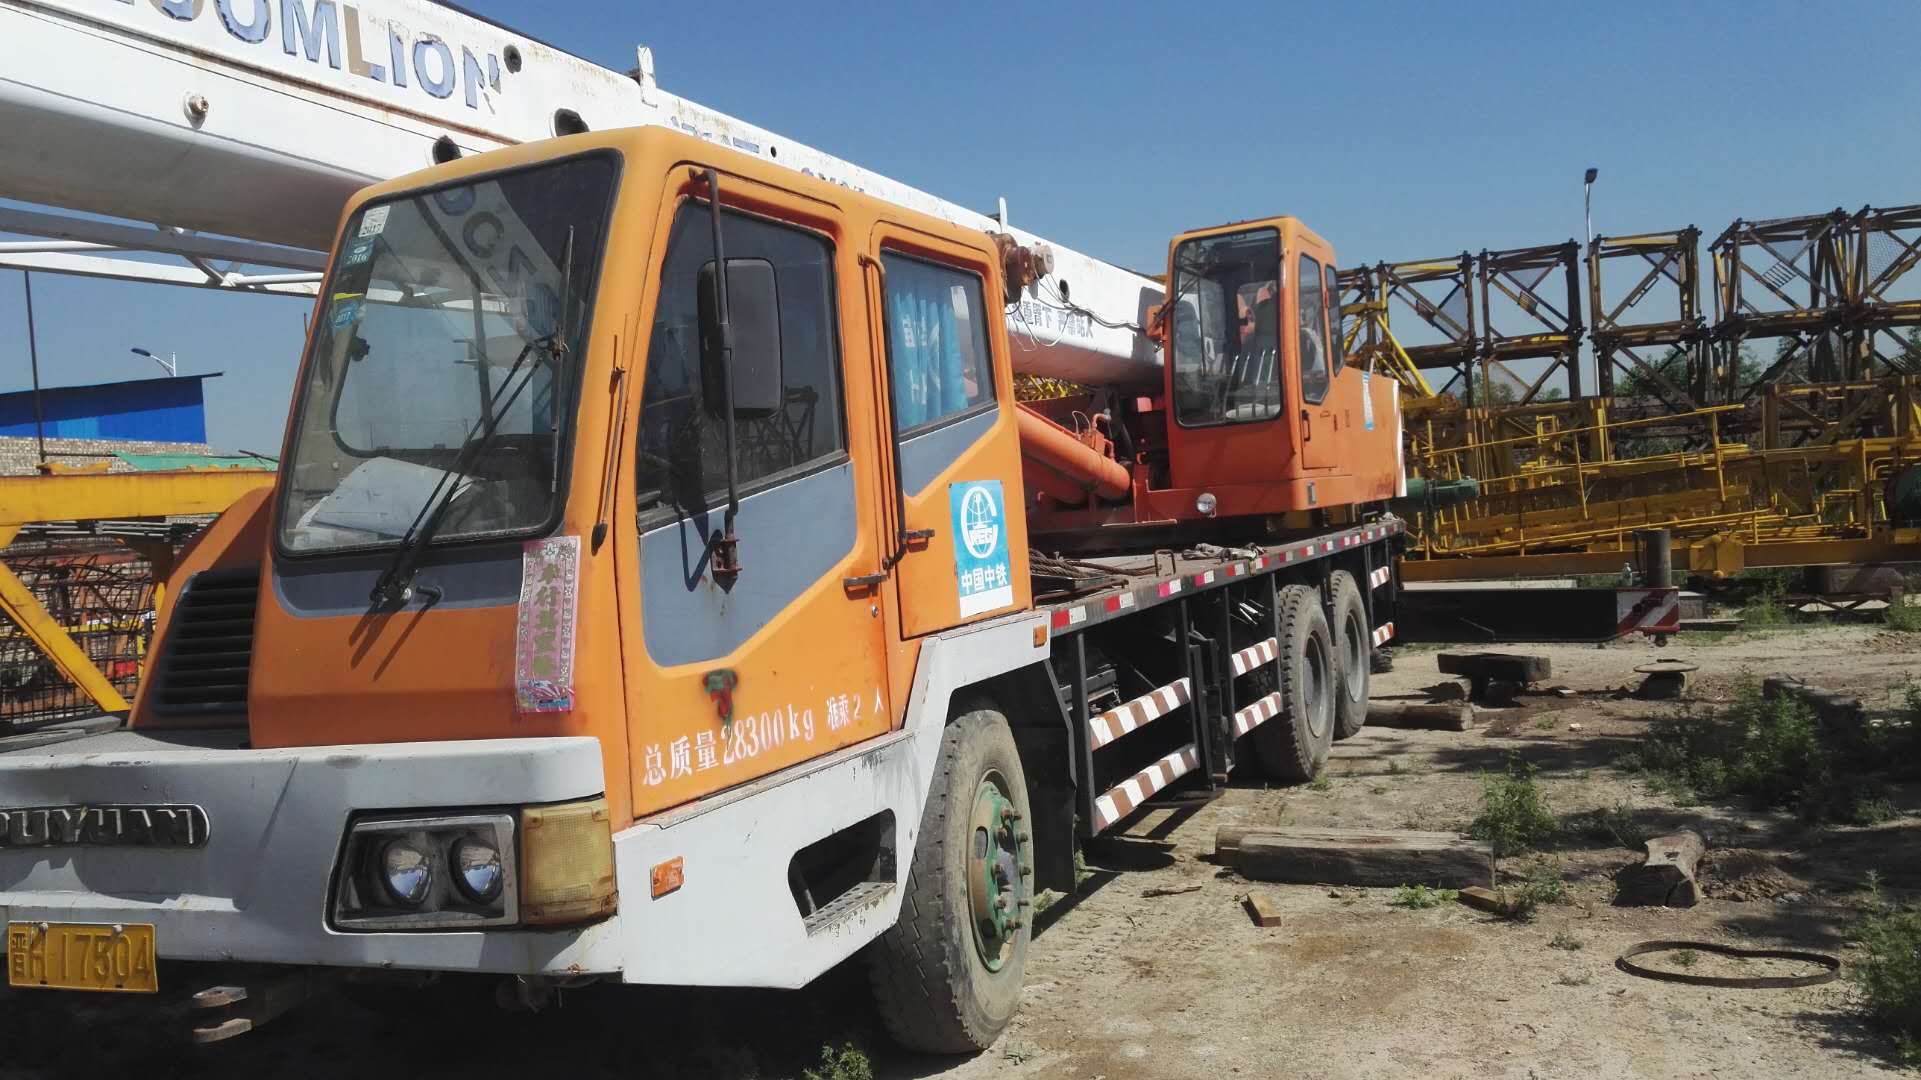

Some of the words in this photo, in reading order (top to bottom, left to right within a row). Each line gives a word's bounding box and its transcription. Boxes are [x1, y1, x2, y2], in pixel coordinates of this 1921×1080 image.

[113, 0, 502, 114] OMLION
[961, 561, 1008, 594] 中国中铁
